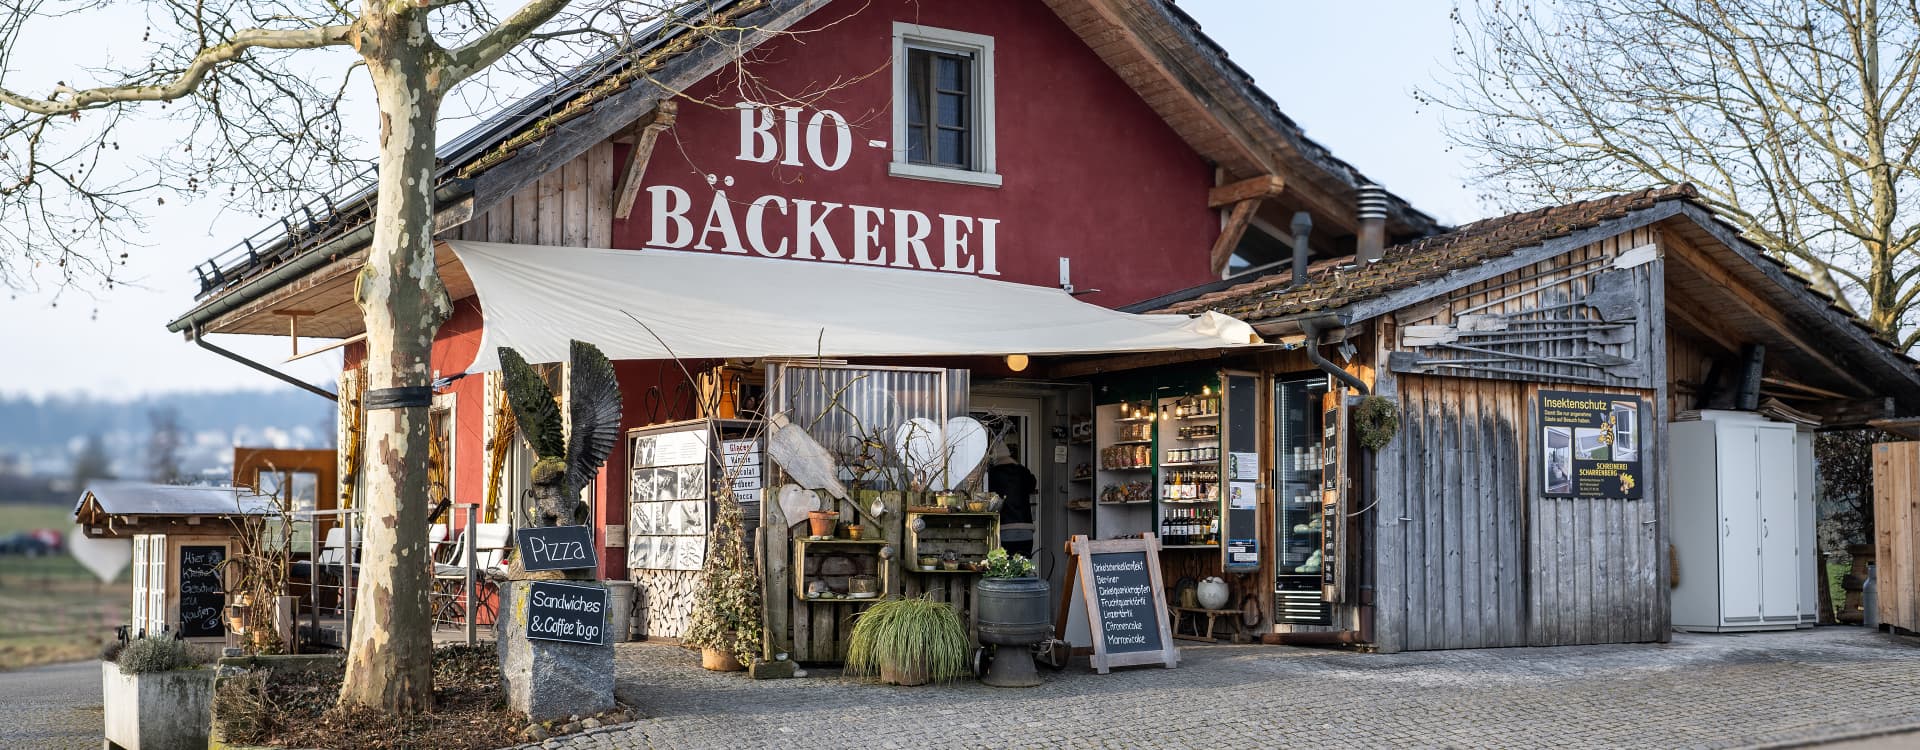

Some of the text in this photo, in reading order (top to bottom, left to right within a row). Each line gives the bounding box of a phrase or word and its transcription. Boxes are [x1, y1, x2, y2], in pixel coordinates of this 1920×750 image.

[735, 101, 852, 171] BIO
[645, 173, 1000, 275] BÄCKEREI
[1544, 396, 1607, 410] Insektenschutz
[730, 456, 751, 464] Vanle
[1596, 463, 1628, 471] SCHREINEREI
[184, 551, 204, 564] Hier
[529, 535, 586, 562] Pizza
[532, 590, 601, 613] Sandwiches
[531, 615, 544, 632] &
[544, 616, 575, 637] Coffee
